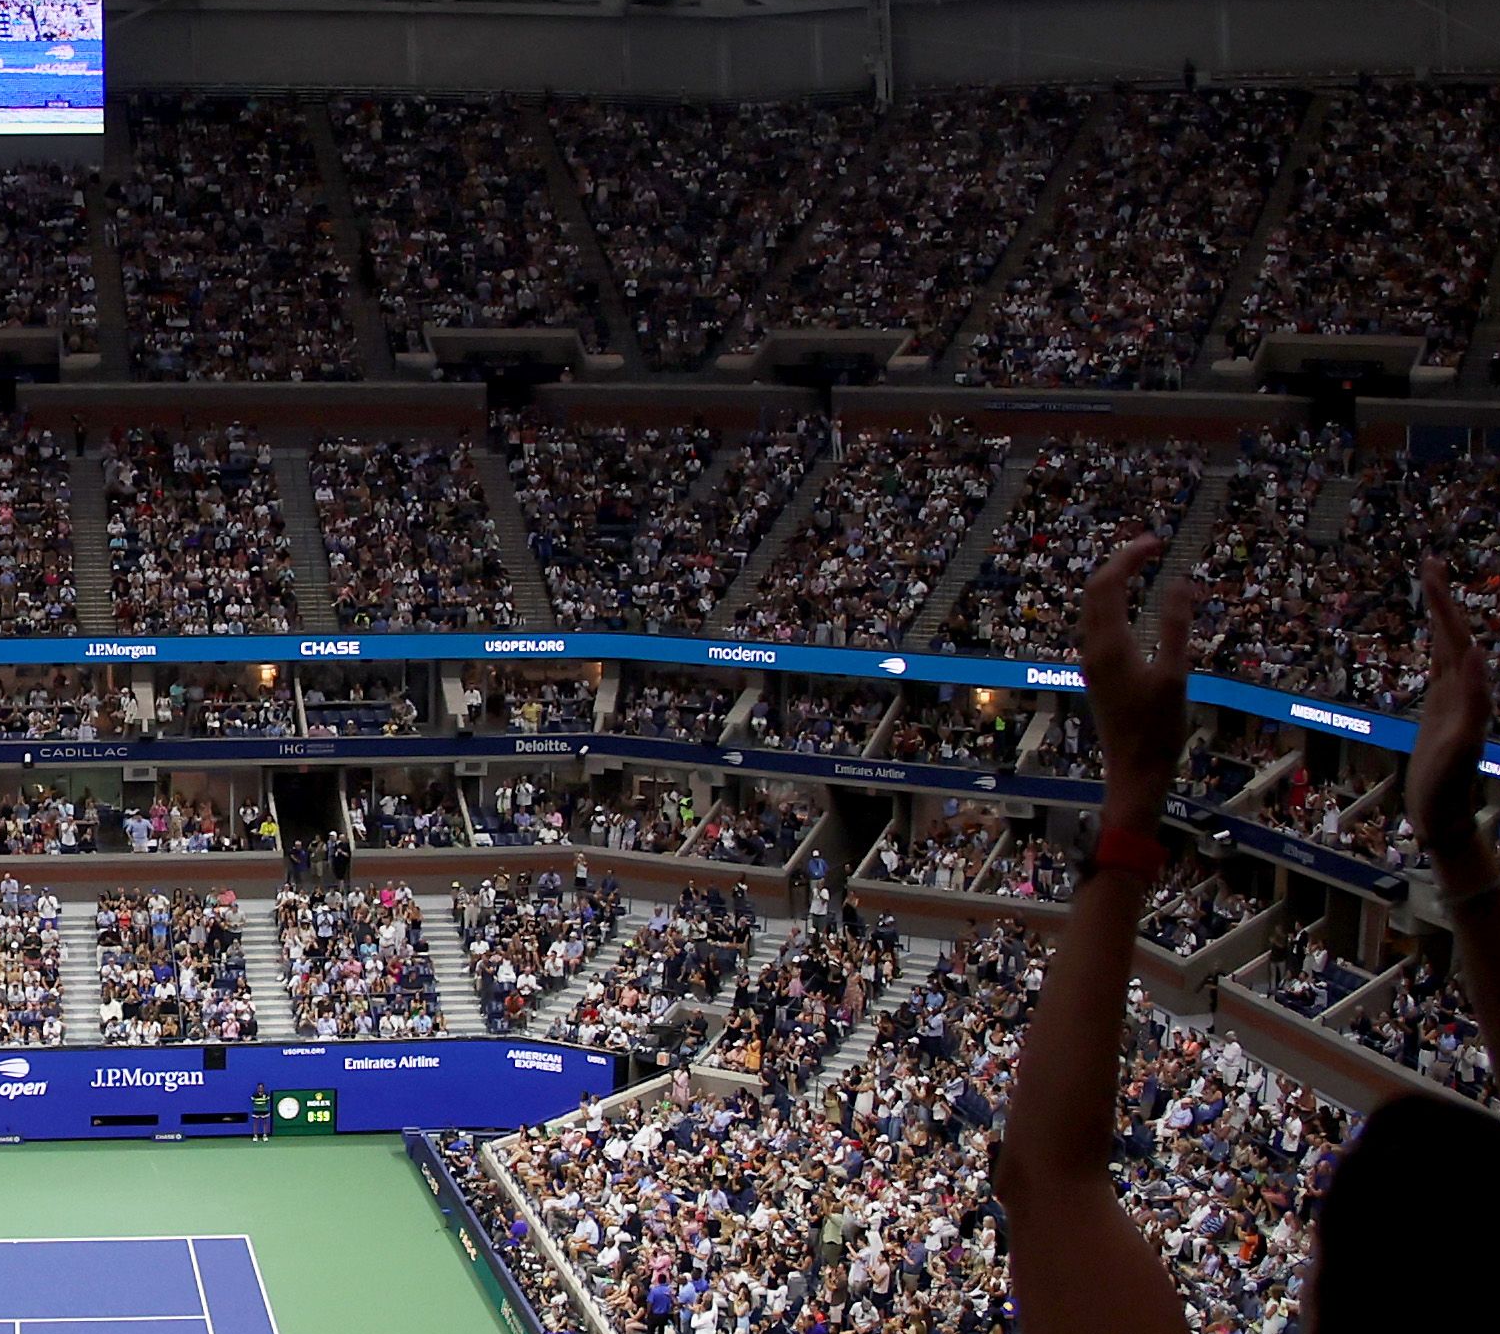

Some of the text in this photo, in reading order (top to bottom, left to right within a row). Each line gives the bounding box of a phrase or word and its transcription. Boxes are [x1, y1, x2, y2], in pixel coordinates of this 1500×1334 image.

[85, 643, 157, 659] J.P.Morgan
[300, 641, 360, 655] CHASE
[485, 640, 564, 652] USOPEN.ORG
[708, 646, 776, 664] moderna
[39, 747, 128, 758] CADILLAC
[280, 744, 304, 755] IHG
[515, 739, 572, 753] Deloitte.
[834, 763, 906, 780] Emirates Airline
[1166, 799, 1188, 818] WTA
[344, 1055, 440, 1070] Emirates Airline
[507, 1049, 562, 1064] AMERICAN
[514, 1058, 563, 1073] EXPRESS
[90, 1068, 204, 1092] J.P.Morgan
